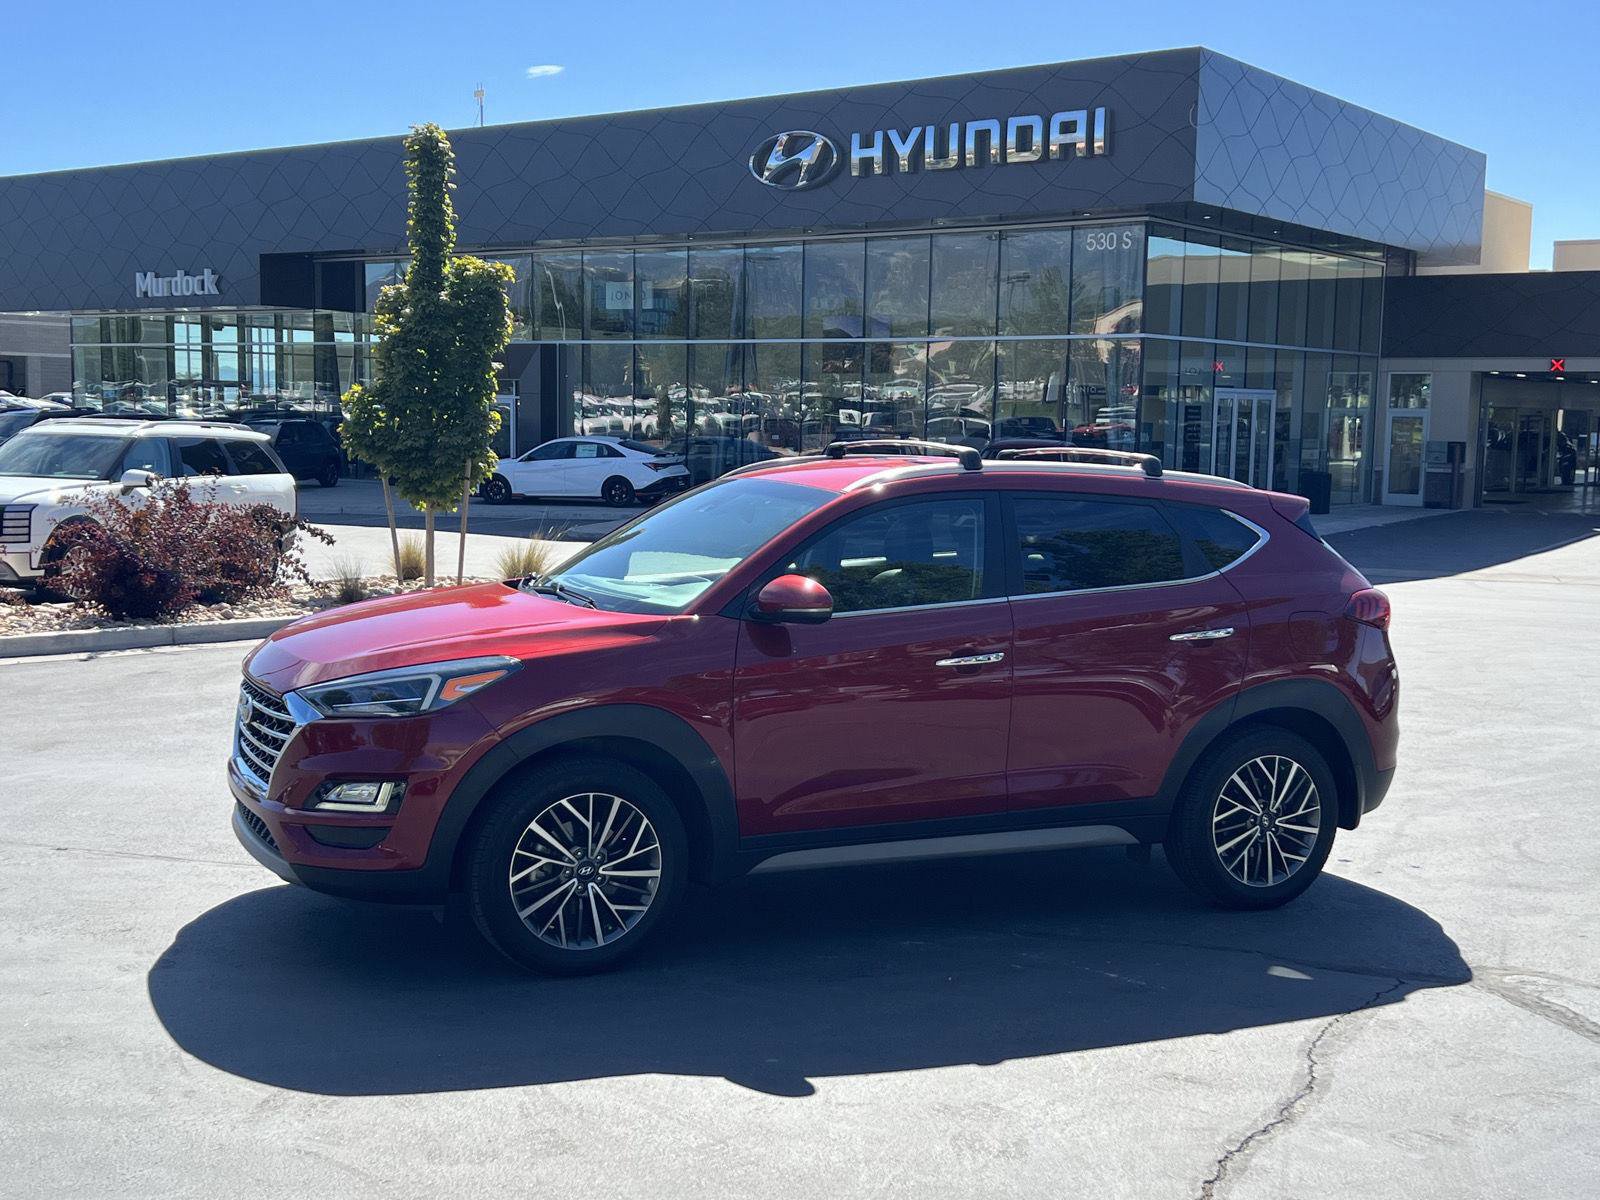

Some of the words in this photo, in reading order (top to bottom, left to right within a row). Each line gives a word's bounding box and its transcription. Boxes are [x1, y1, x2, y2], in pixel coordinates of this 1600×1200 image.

[851, 107, 1107, 177] HYUNDAI
[1086, 232, 1117, 251] 530
[1122, 231, 1132, 249] S
[135, 268, 220, 298] Murdock
